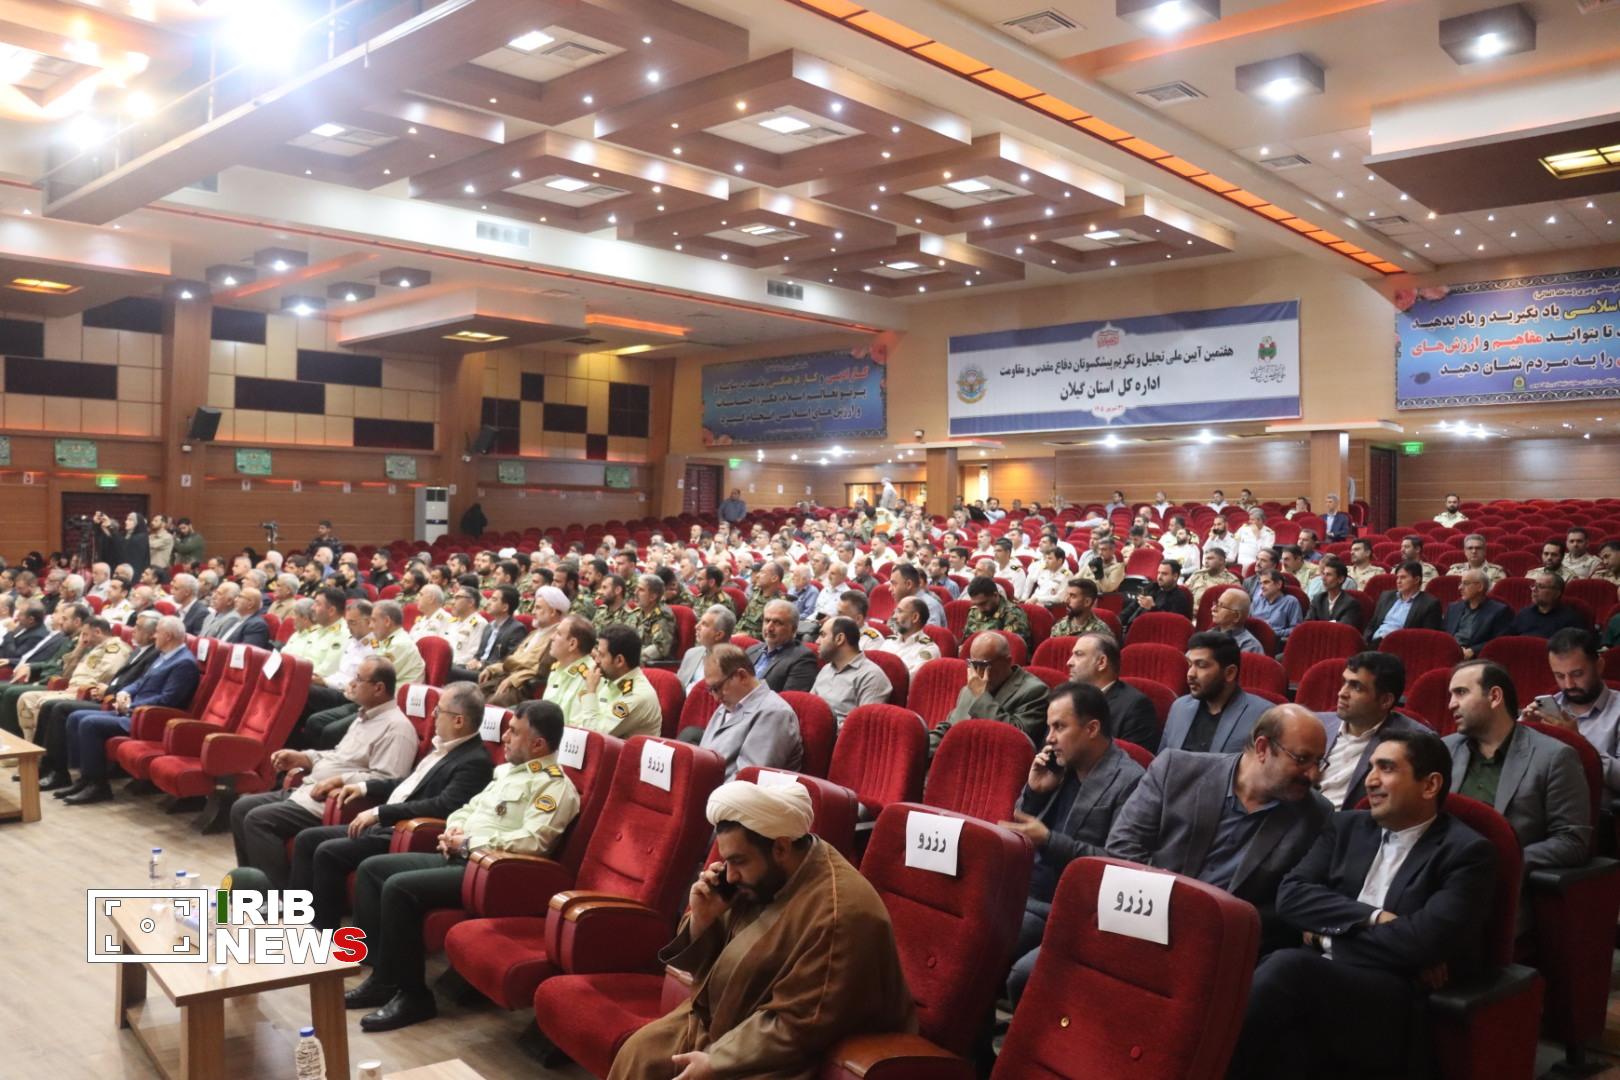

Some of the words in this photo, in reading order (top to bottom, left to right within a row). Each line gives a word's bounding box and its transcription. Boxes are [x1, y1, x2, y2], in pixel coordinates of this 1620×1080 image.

[1458, 311, 1475, 328] یاد
[1488, 305, 1539, 324] بگیرید
[1542, 303, 1560, 320] یاد
[1411, 316, 1455, 331] بدهید
[1479, 314, 1486, 328] و
[1545, 326, 1599, 345] بتوانید
[1602, 324, 1614, 338] تا
[1482, 339, 1489, 352] و
[1492, 332, 1543, 349] مفاهیم
[1113, 353, 1135, 370] تکریم
[1141, 351, 1165, 367] تجلیل
[1166, 349, 1182, 365] ملی
[1204, 345, 1234, 362] هفتمین
[1573, 355, 1597, 369] به
[1600, 351, 1613, 368] را
[999, 364, 1025, 378] مقاومت
[1031, 361, 1054, 376] مقدس
[1054, 359, 1072, 375] دفاع
[1073, 356, 1113, 373] پیشکسوتان
[1135, 357, 1140, 368] و
[1440, 362, 1479, 377] دهید
[1482, 359, 1522, 376] نشان
[1525, 358, 1569, 373] مردم
[1060, 381, 1086, 400] گیلان
[1087, 379, 1114, 399] استان
[1117, 378, 1133, 397] کل
[1135, 375, 1160, 396] اداره
[917, 830, 947, 854] رزرو
[1113, 889, 1153, 917] رزرو
